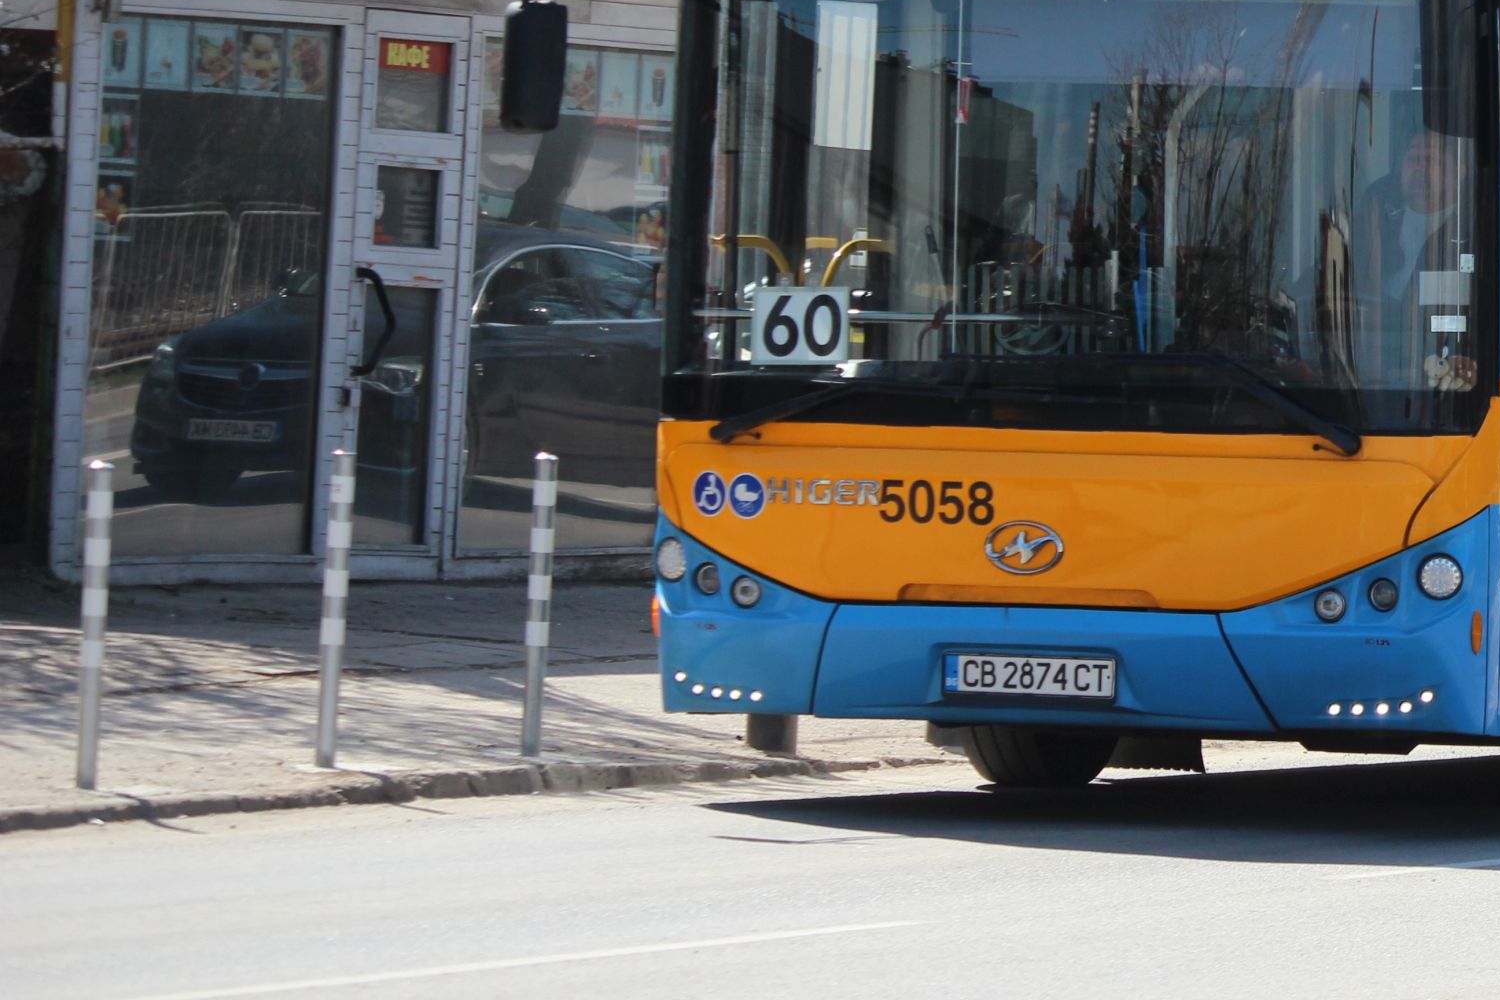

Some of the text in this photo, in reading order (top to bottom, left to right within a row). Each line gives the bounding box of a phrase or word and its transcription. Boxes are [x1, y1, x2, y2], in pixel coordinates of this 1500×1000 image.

[387, 42, 431, 69] КАФЕ
[763, 294, 842, 357] 60
[766, 477, 881, 506] HIGER
[879, 479, 995, 525] 5058
[963, 660, 1109, 692] CB 2874 CT
